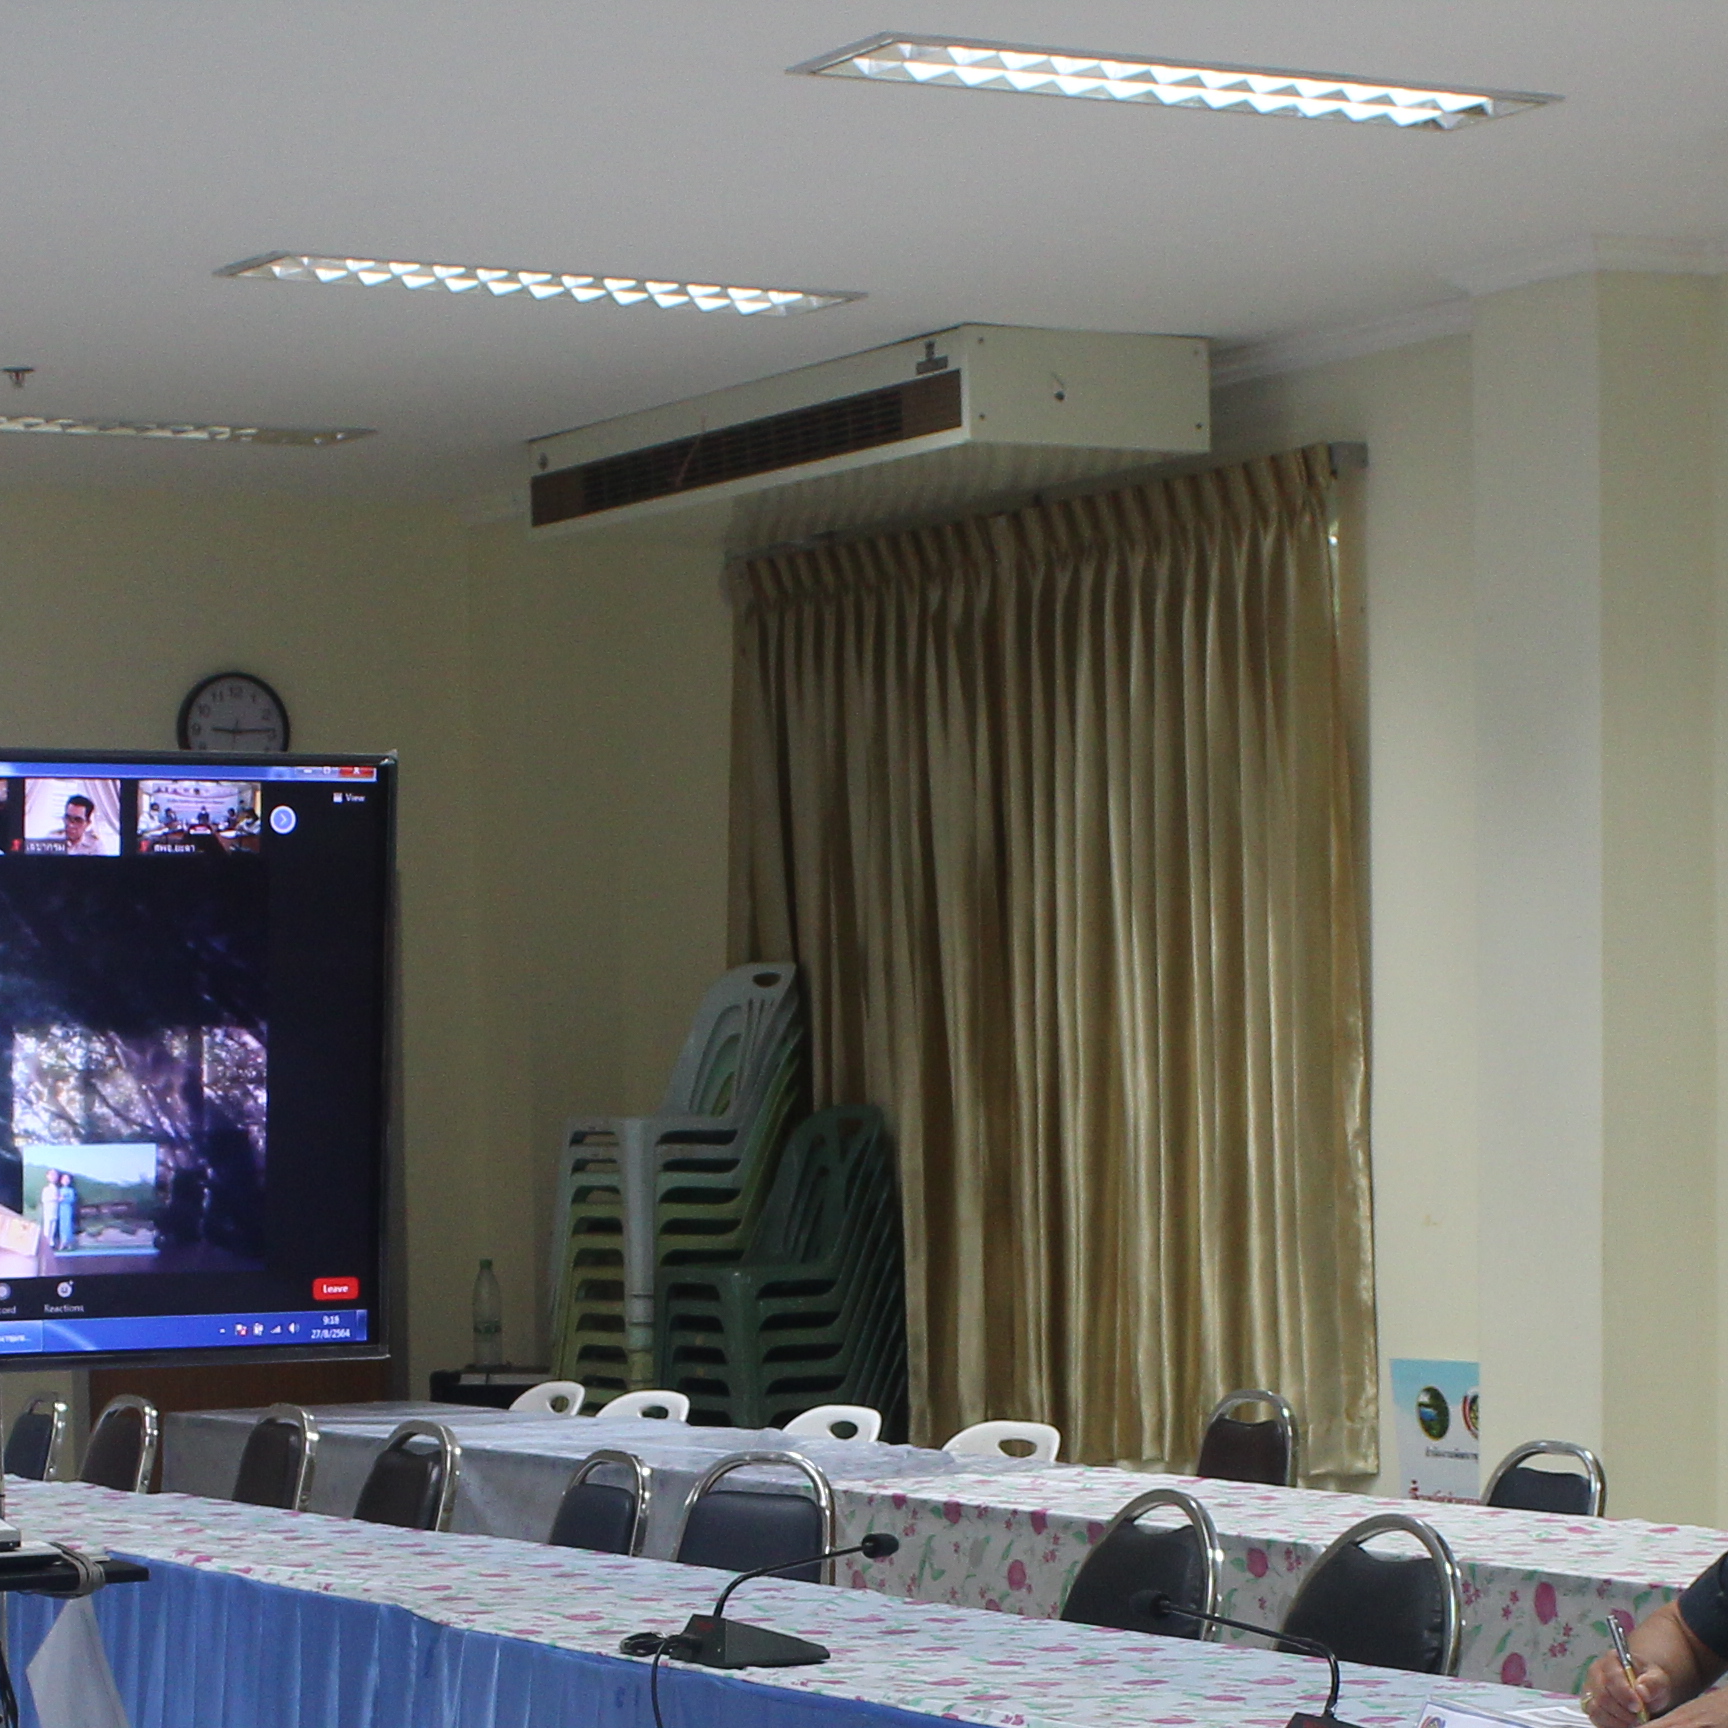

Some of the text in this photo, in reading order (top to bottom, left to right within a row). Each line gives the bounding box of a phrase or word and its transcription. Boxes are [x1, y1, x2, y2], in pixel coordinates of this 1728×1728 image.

[345, 793, 366, 802] View
[323, 1284, 349, 1294] Leave
[44, 1303, 85, 1314] Reactions
